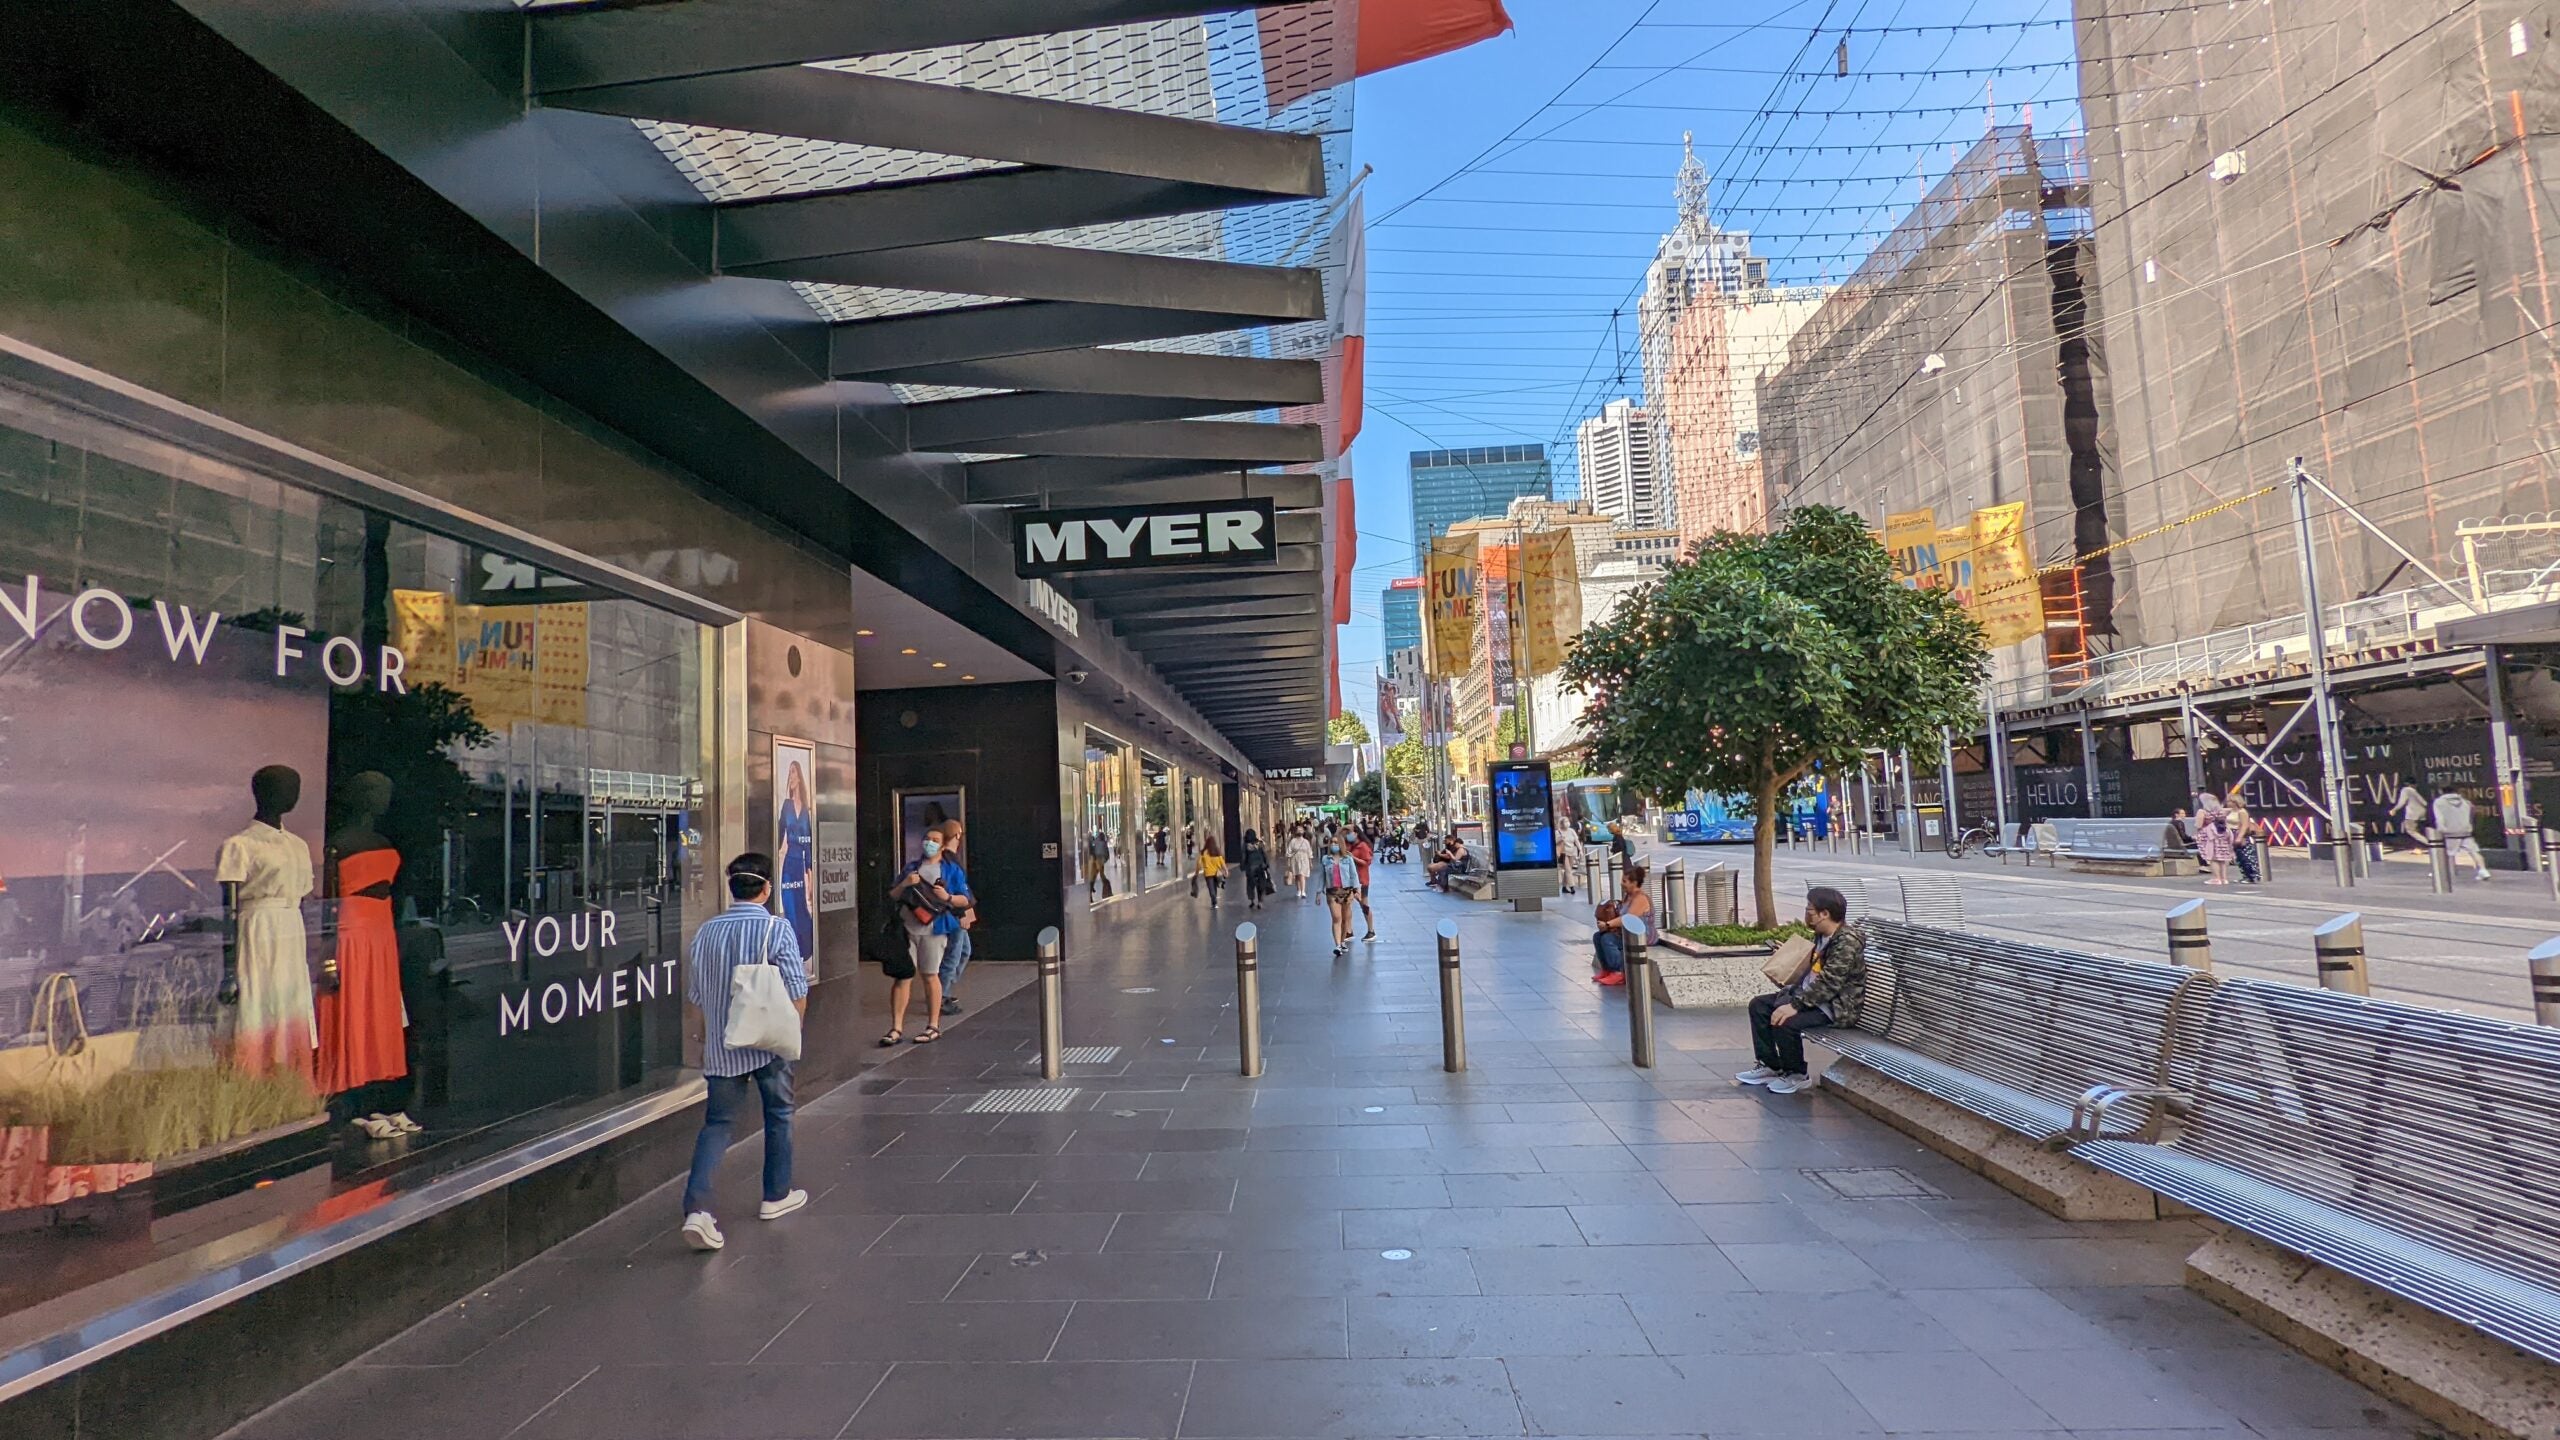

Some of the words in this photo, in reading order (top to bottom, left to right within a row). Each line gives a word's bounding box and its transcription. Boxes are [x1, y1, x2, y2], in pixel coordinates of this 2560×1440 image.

[1025, 510, 1264, 563] MYER
[1432, 568, 1473, 600] FUN
[1030, 578, 1079, 638] MYER
[0, 574, 221, 664] NOW
[276, 624, 406, 694] FOR
[2425, 754, 2482, 769] UNIQUE
[1265, 767, 1314, 778] MYER
[2428, 771, 2476, 783] RETAIL
[2026, 783, 2078, 806] HELLO
[822, 847, 852, 863] 314-336
[782, 880, 804, 889] MOMENT
[822, 868, 849, 884] Bourke
[822, 888, 847, 905] Street
[501, 910, 617, 962] YOUR
[500, 959, 676, 1036] MOMENT
